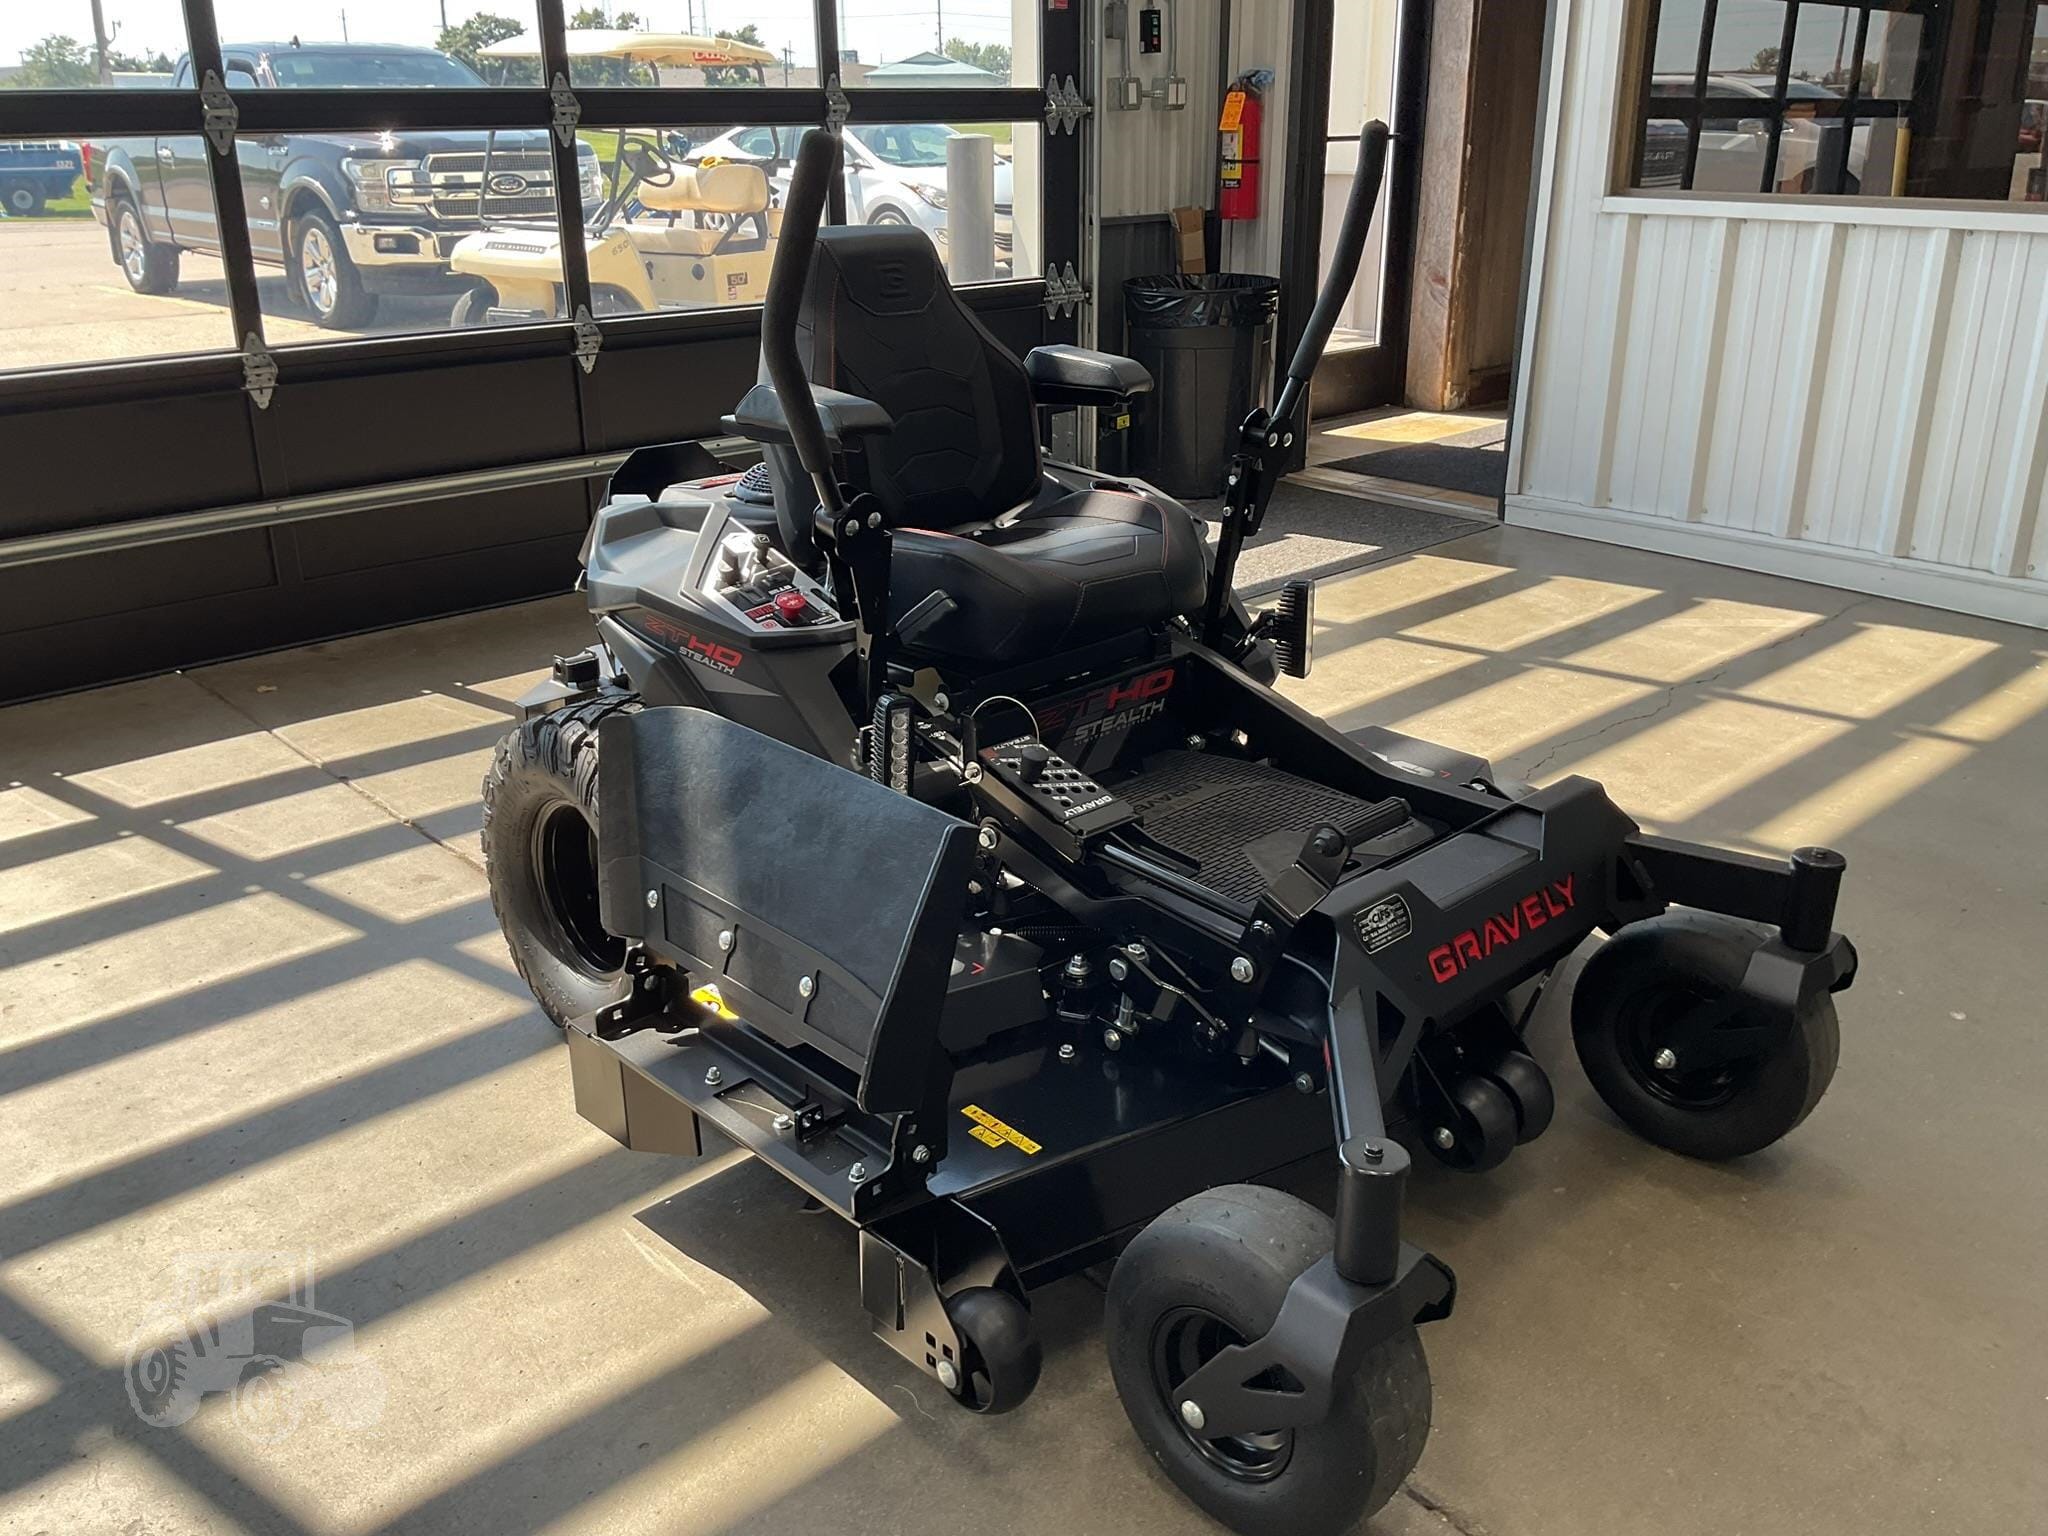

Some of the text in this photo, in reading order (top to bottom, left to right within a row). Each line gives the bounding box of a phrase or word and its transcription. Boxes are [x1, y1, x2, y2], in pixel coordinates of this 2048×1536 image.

[679, 646, 736, 675] STEALTH
[1074, 697, 1166, 742] STEALTH
[994, 734, 1032, 751] STEALTH
[1063, 795, 1113, 818] GRAVELY
[1427, 872, 1577, 984] GRAVELY
